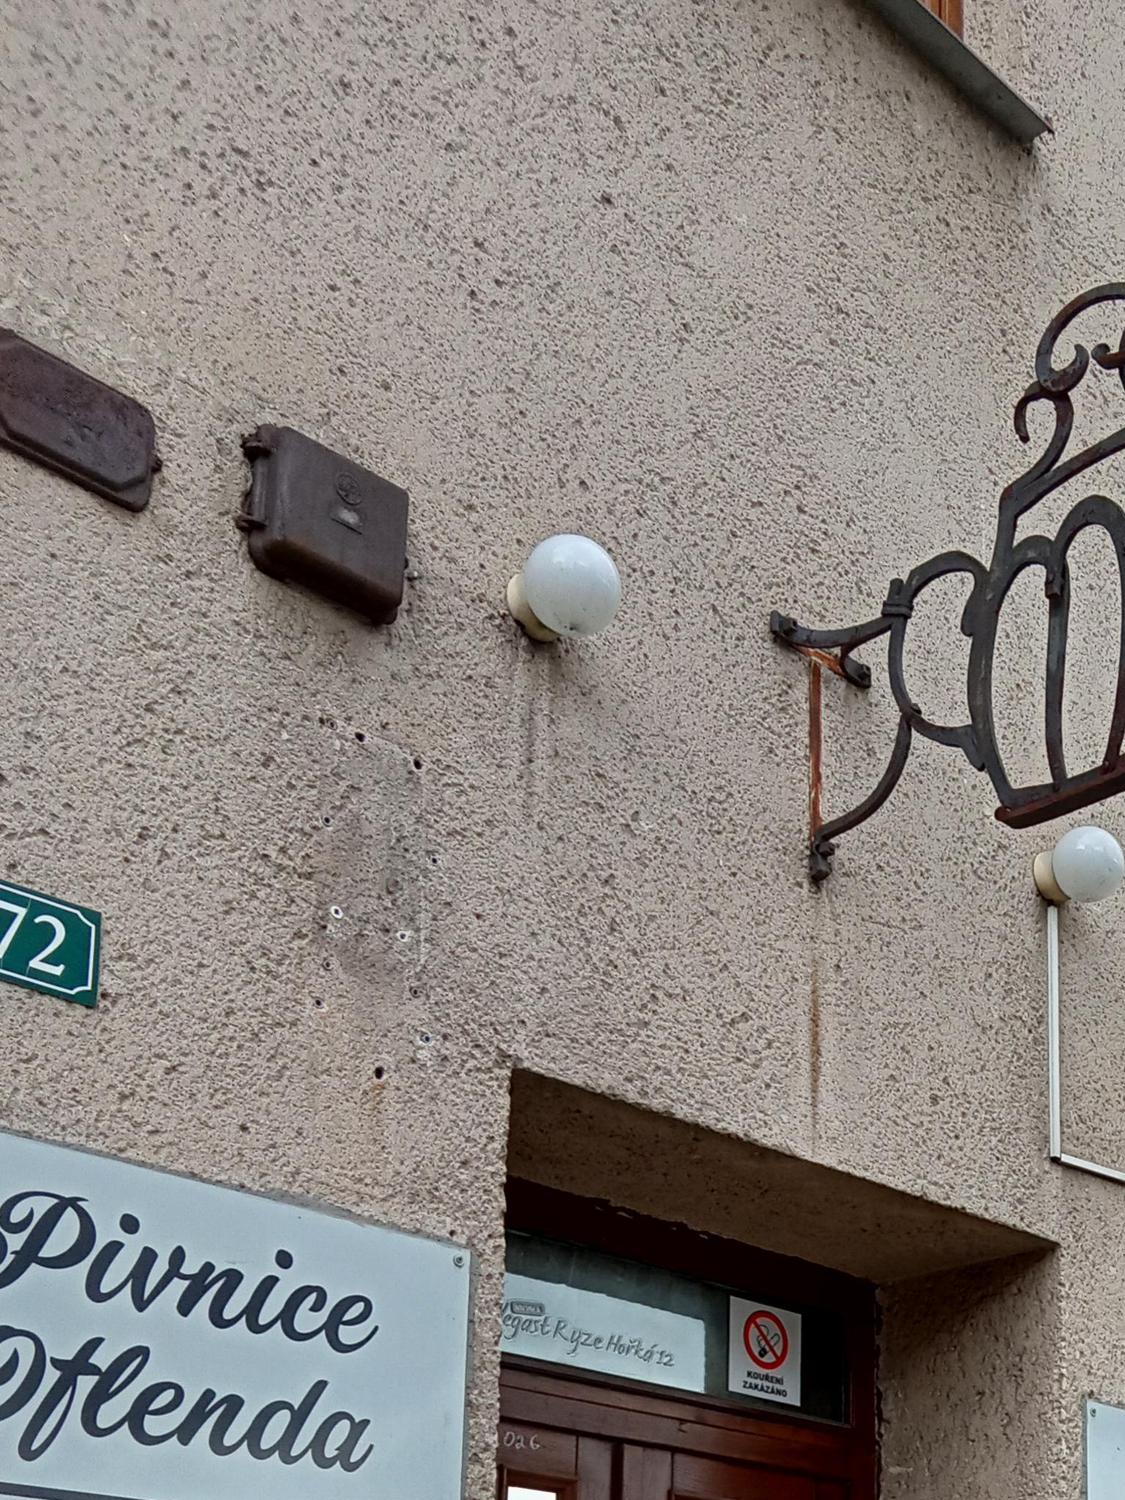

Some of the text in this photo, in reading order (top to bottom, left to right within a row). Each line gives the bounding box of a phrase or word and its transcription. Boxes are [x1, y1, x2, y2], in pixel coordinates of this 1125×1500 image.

[0, 1190, 379, 1354] Pivnice
[501, 1312, 550, 1341] egast
[742, 1379, 788, 1398] ZAKÁZÁNO
[746, 1370, 784, 1386] KOUŘENÍ
